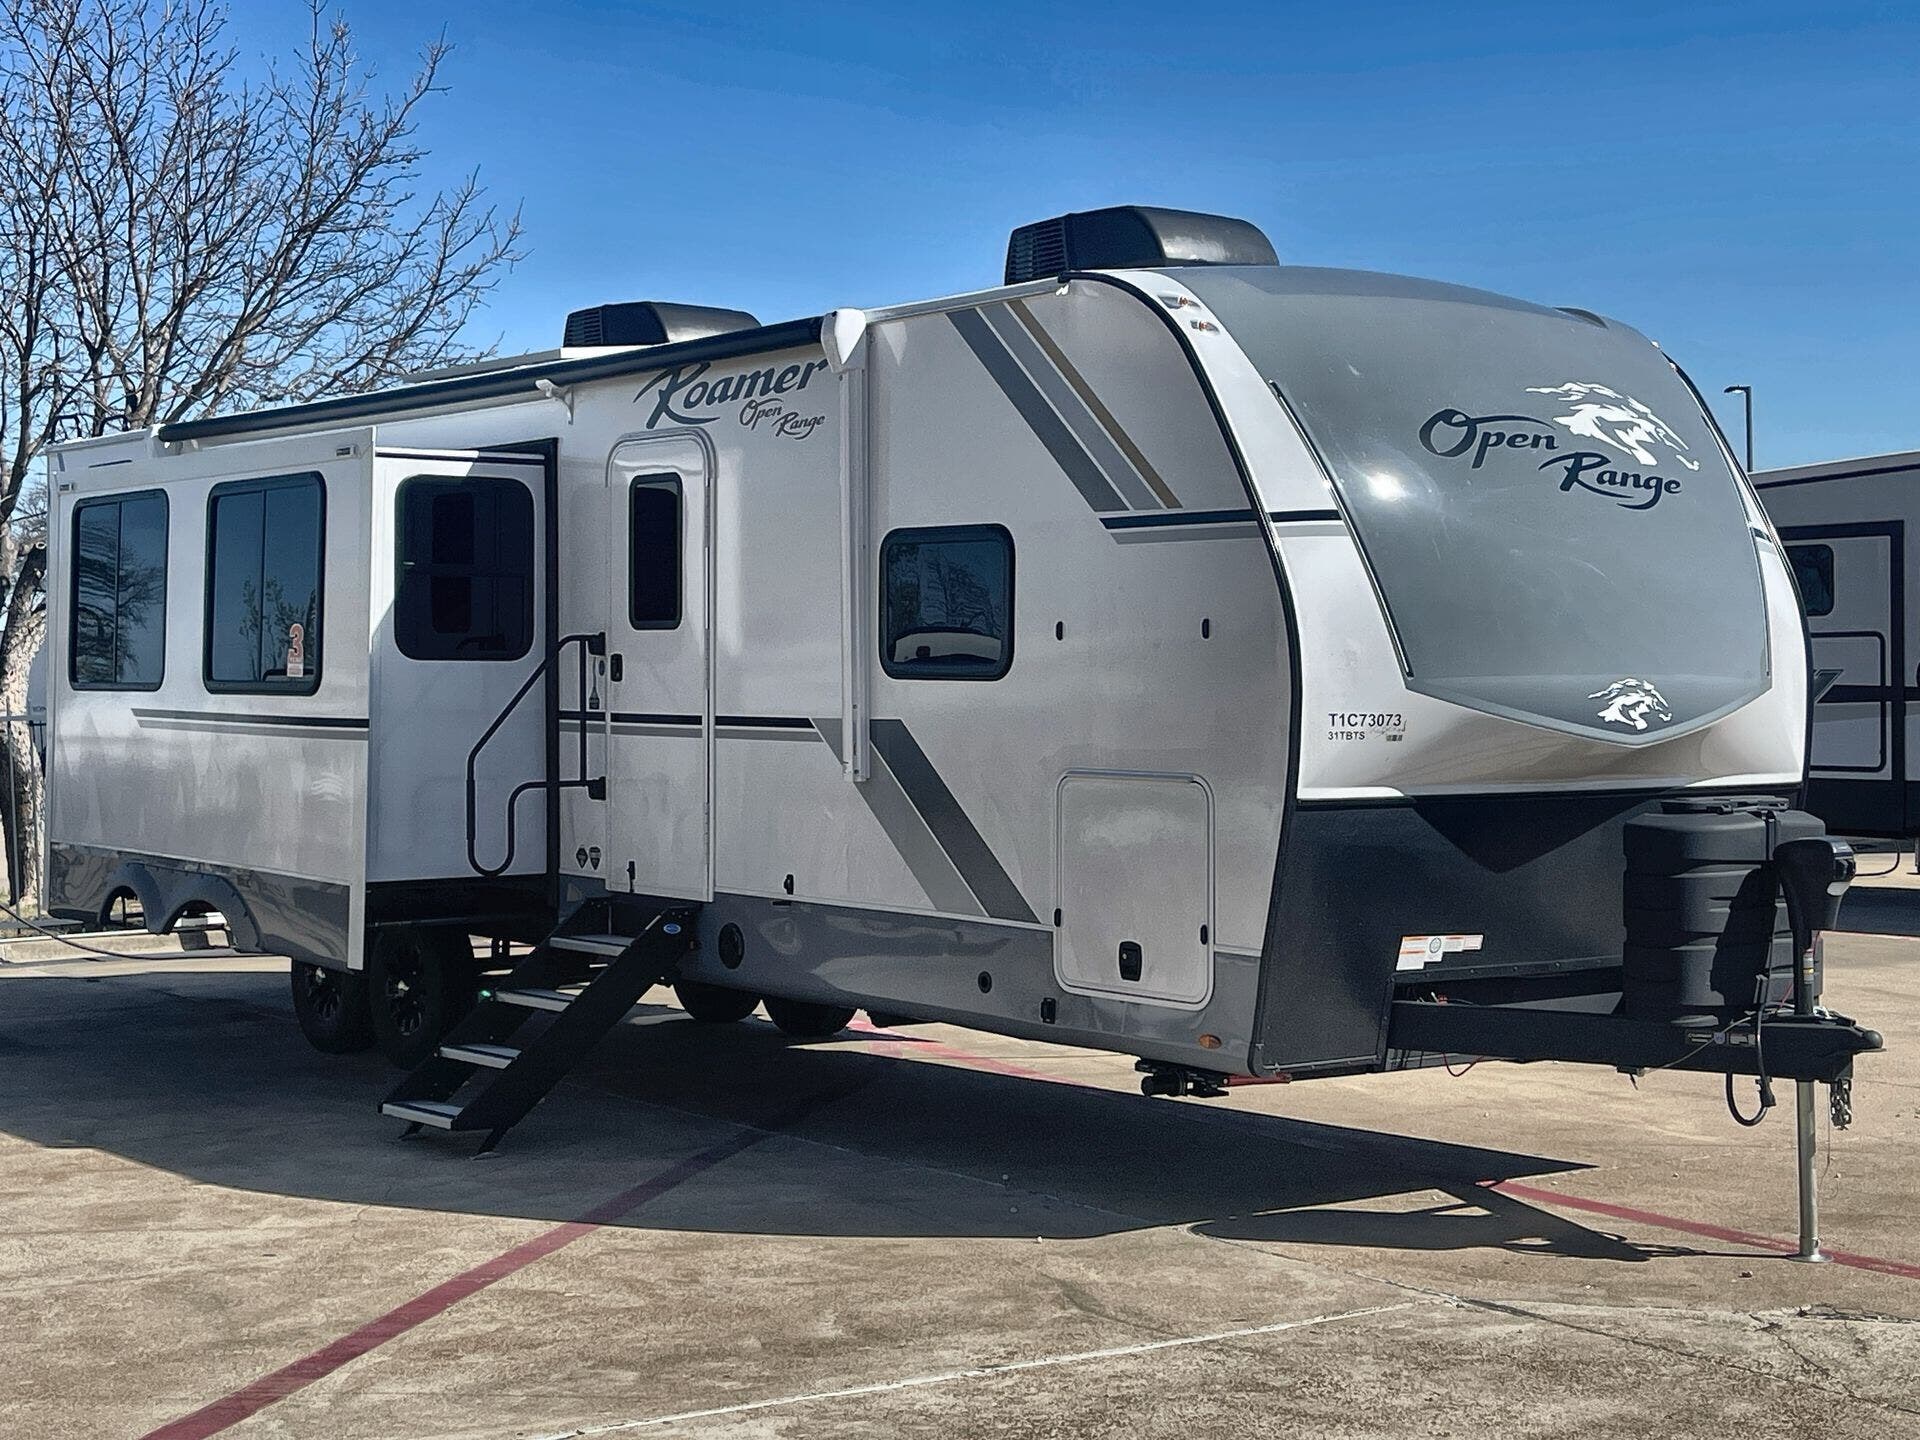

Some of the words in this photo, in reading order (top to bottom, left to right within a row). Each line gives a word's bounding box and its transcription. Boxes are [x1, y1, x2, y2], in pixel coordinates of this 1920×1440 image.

[633, 361, 829, 429] Roamer
[739, 398, 783, 430] Open
[771, 412, 826, 440] Range
[1419, 408, 1559, 469] Open
[1538, 452, 1682, 510] Range
[1328, 713, 1402, 727] T1C73073
[1328, 731, 1366, 741] 31TBTS
